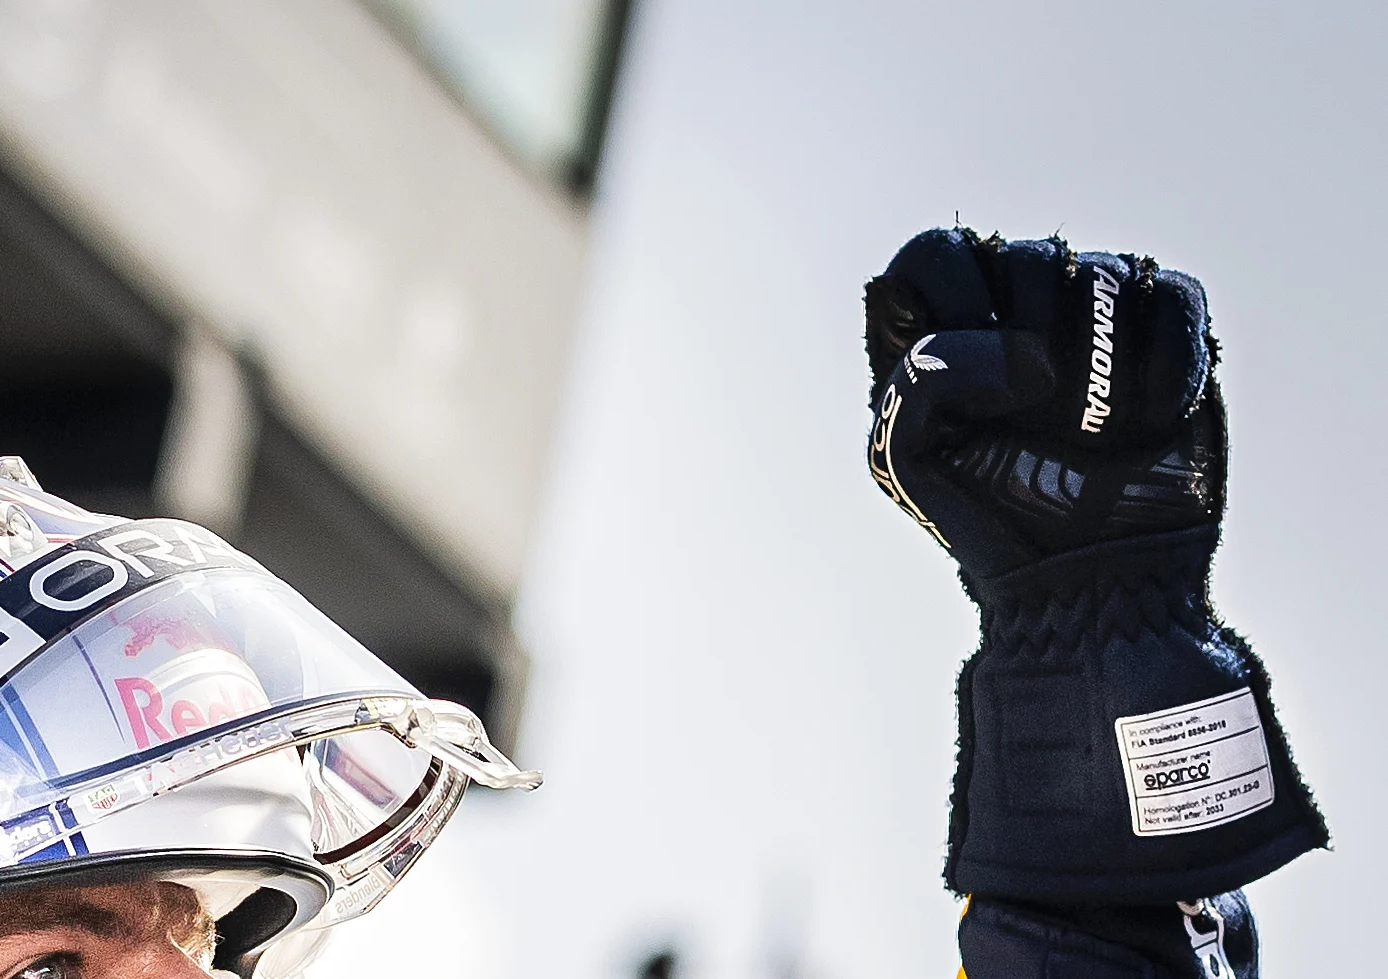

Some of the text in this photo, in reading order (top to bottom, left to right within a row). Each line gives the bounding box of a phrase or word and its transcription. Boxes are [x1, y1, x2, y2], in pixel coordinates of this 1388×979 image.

[1138, 719, 1183, 737] compliance
[1131, 739, 1147, 750] FIA
[1148, 731, 1186, 746] Standard
[1136, 755, 1188, 771] Manufacturer
[1143, 800, 1200, 816] Homologation
[1144, 815, 1160, 826] Not
[1162, 812, 1181, 824] valid
[1205, 803, 1225, 817] 2033
